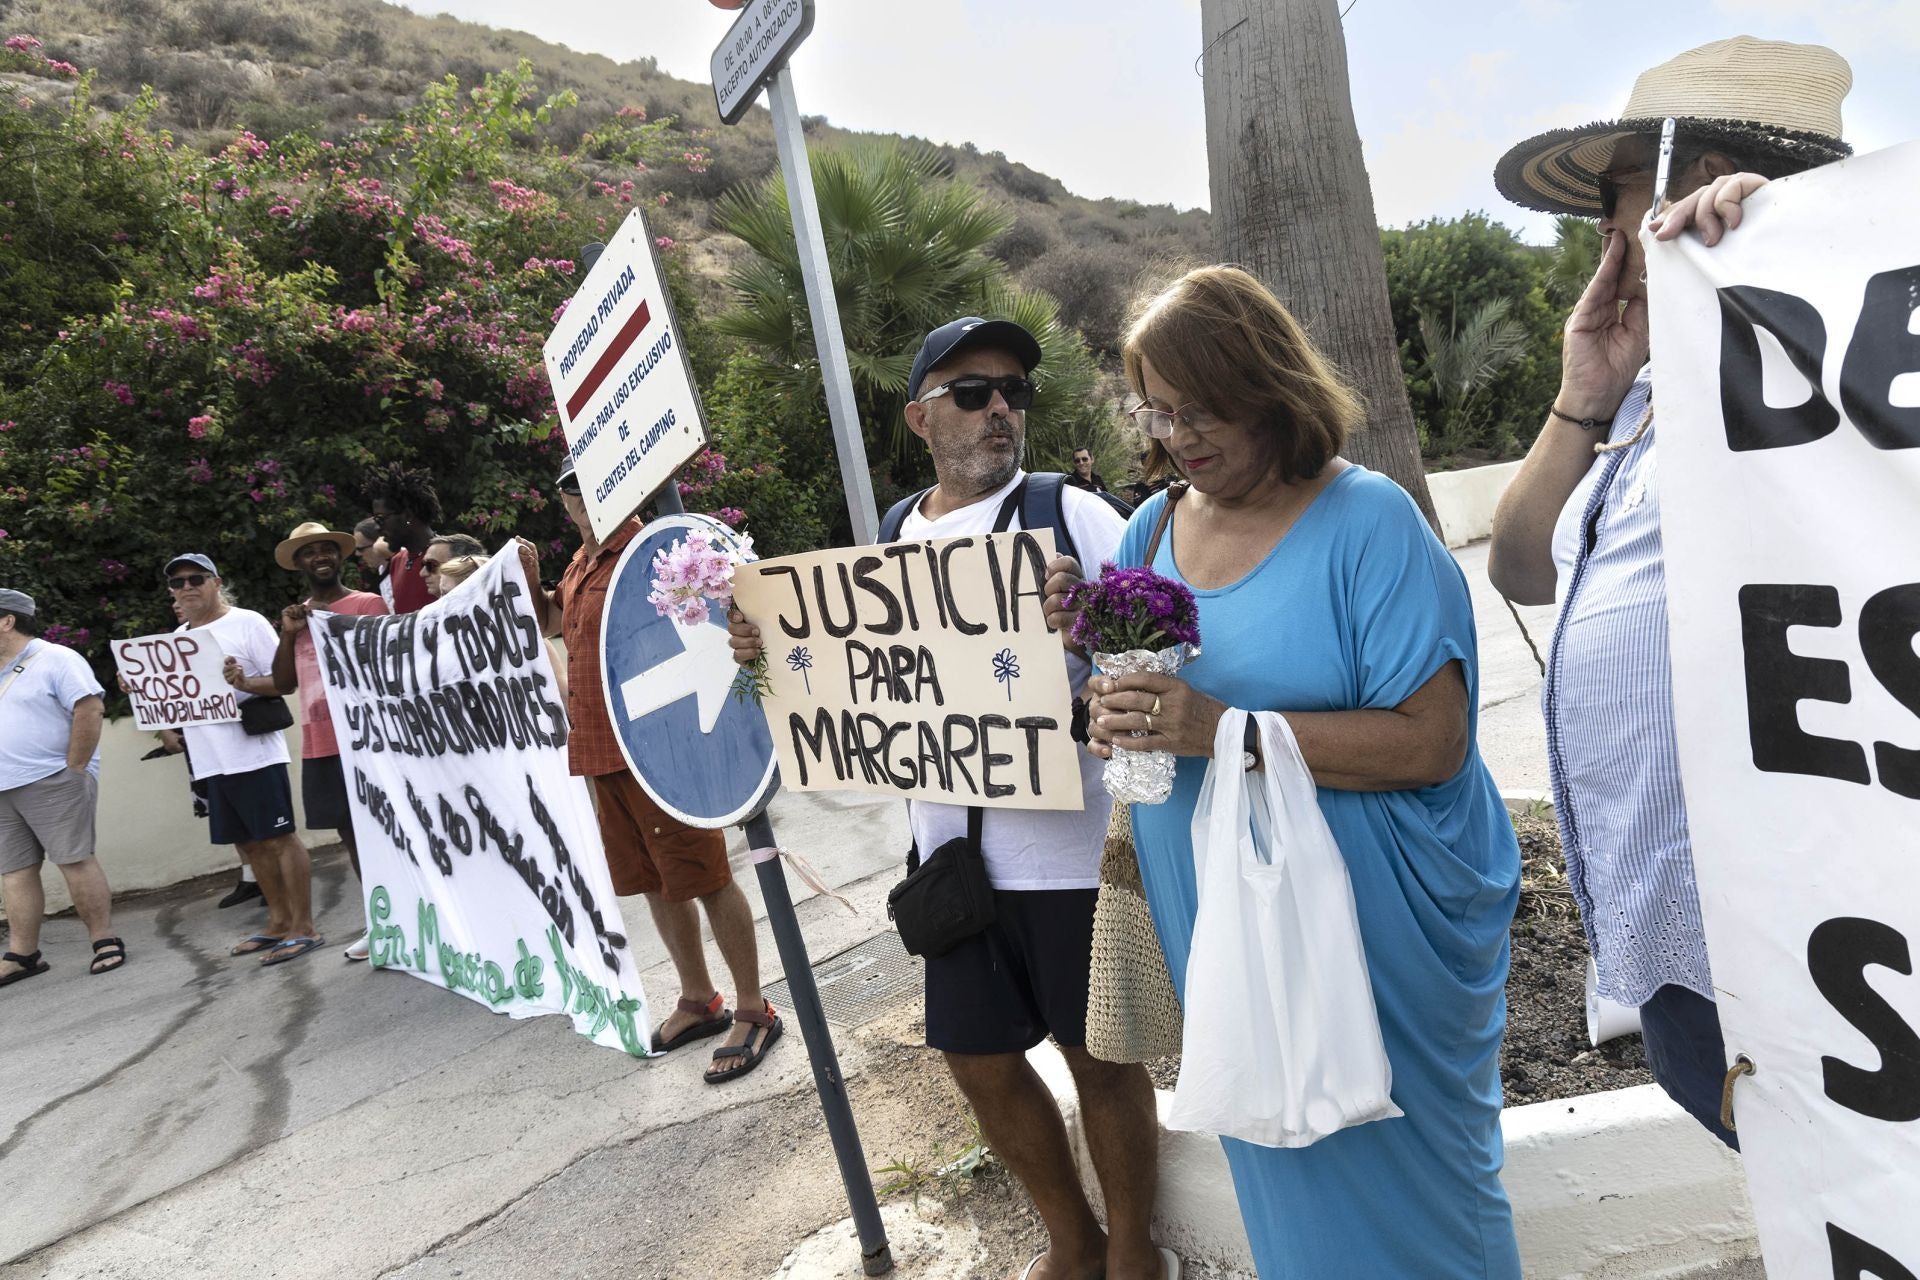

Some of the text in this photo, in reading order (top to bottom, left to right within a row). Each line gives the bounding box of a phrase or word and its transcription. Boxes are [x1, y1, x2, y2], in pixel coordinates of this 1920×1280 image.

[720, 0, 798, 105] EXCEPTO AUTORIZADOS
[724, 0, 781, 71] DE 00:00 A 08:
[559, 264, 636, 380] PROPIEDAD PRIVADA
[571, 331, 672, 463] PARKING PARA USO EXCLUSIVO
[618, 420, 630, 442] DE
[596, 408, 676, 504] CLIENTES DEL CAMPING
[120, 637, 199, 675] STOP
[443, 581, 539, 680] TODOS
[129, 674, 201, 704] ACOSO
[136, 692, 237, 724] INMOBILIARIO
[845, 639, 945, 706] PARA
[788, 706, 1059, 799] MARGARET
[513, 937, 545, 1000] de
